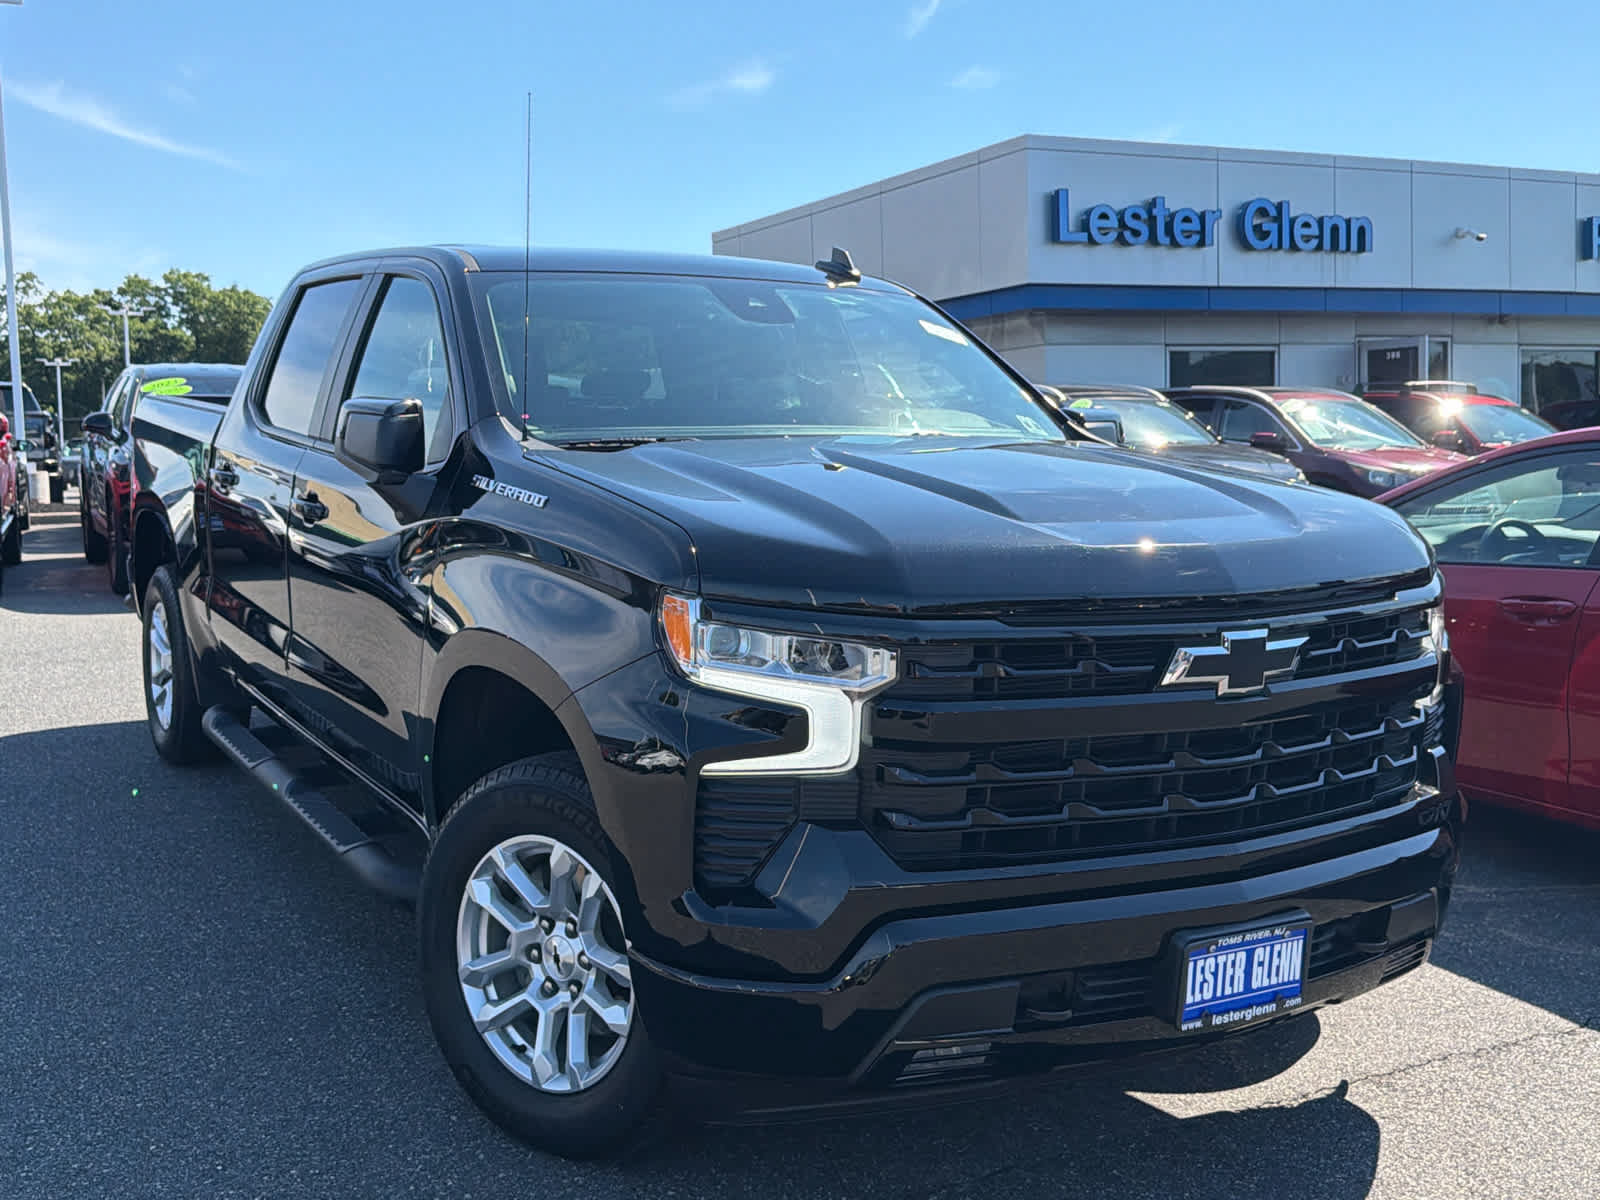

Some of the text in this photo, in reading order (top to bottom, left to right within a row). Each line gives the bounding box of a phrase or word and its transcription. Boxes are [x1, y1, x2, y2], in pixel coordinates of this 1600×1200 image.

[1054, 188, 1373, 253] Lester Glenn
[471, 474, 548, 507] SILVERADO
[1217, 934, 1243, 947] TOMS
[1273, 927, 1286, 937] NJ
[1185, 939, 1304, 1004] LESTER GLENN
[1212, 1003, 1276, 1025] lesterglenn
